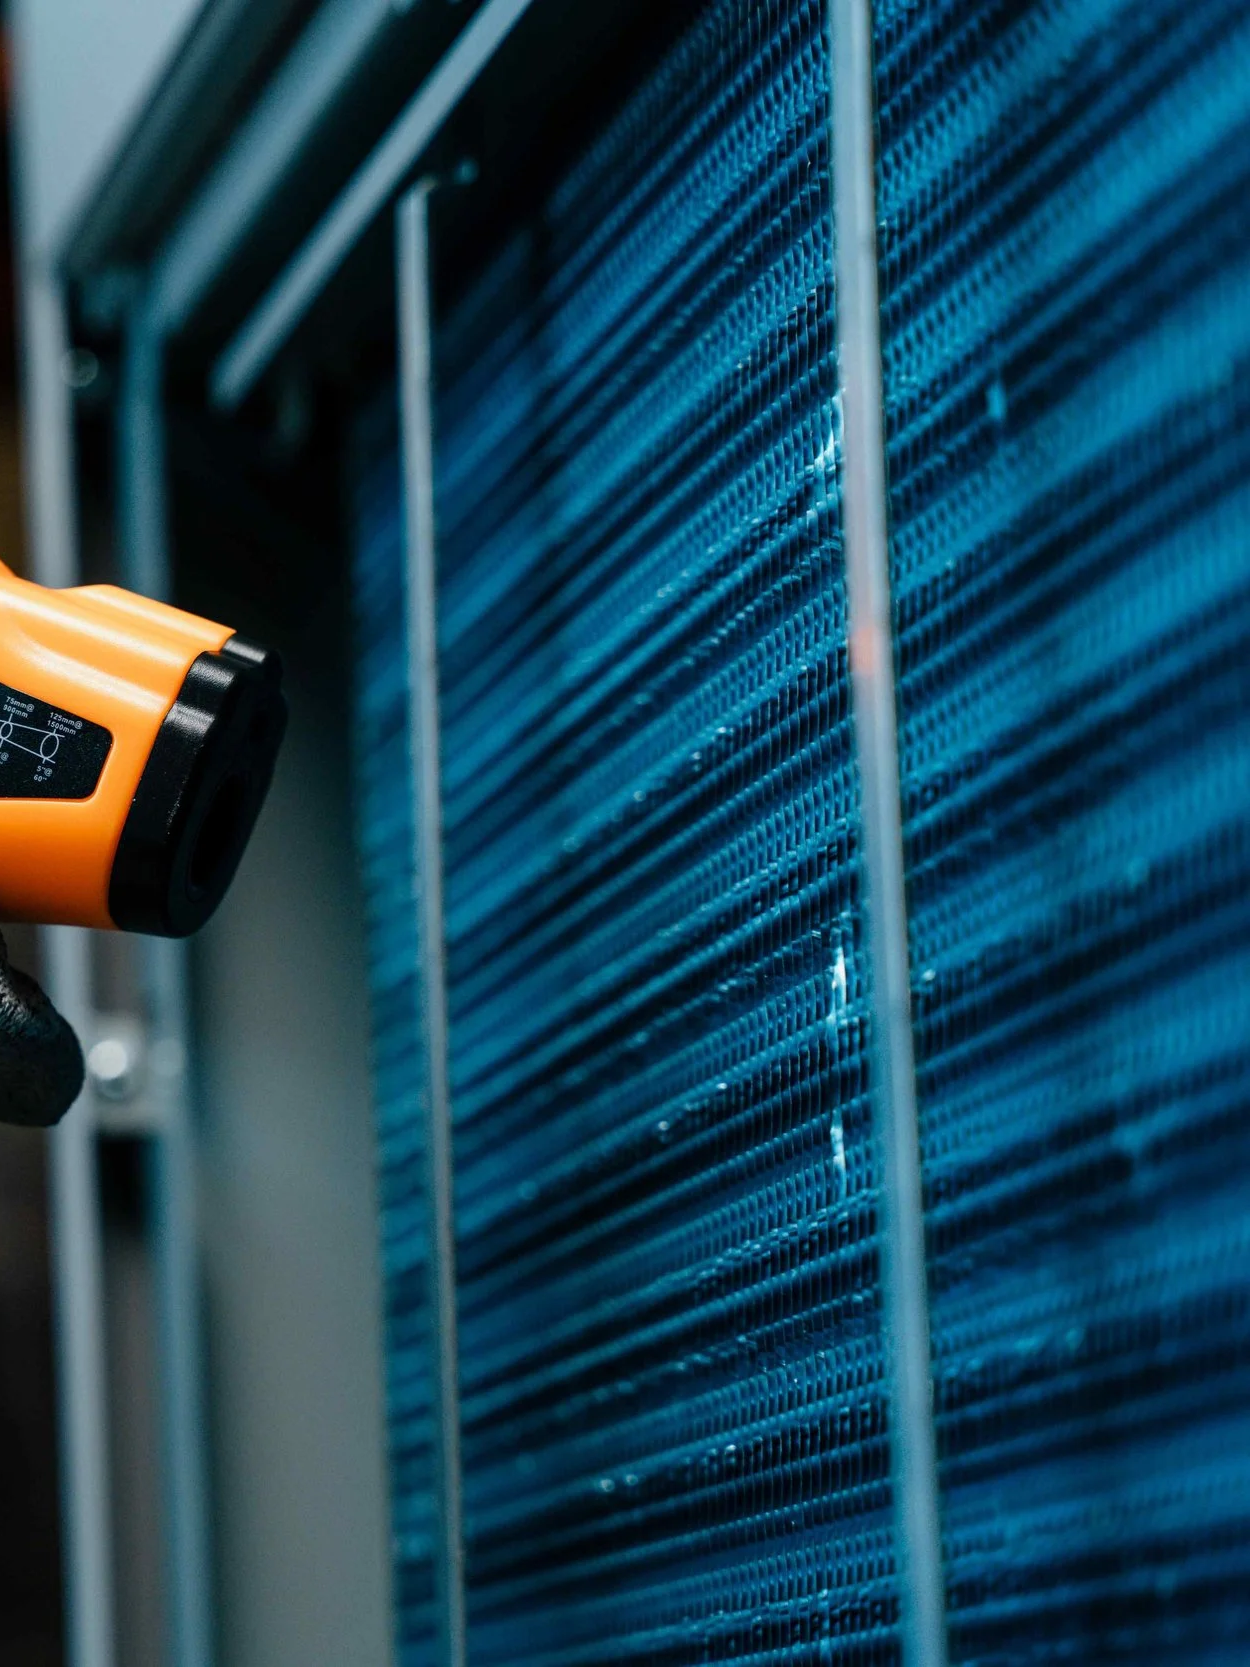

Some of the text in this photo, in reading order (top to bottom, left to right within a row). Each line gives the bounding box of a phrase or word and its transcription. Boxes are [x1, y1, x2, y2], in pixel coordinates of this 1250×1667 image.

[3, 705, 28, 718] 900mm
[6, 696, 34, 712] 75mm@
[47, 720, 76, 735] 1500mm
[50, 712, 82, 729] 125mm@
